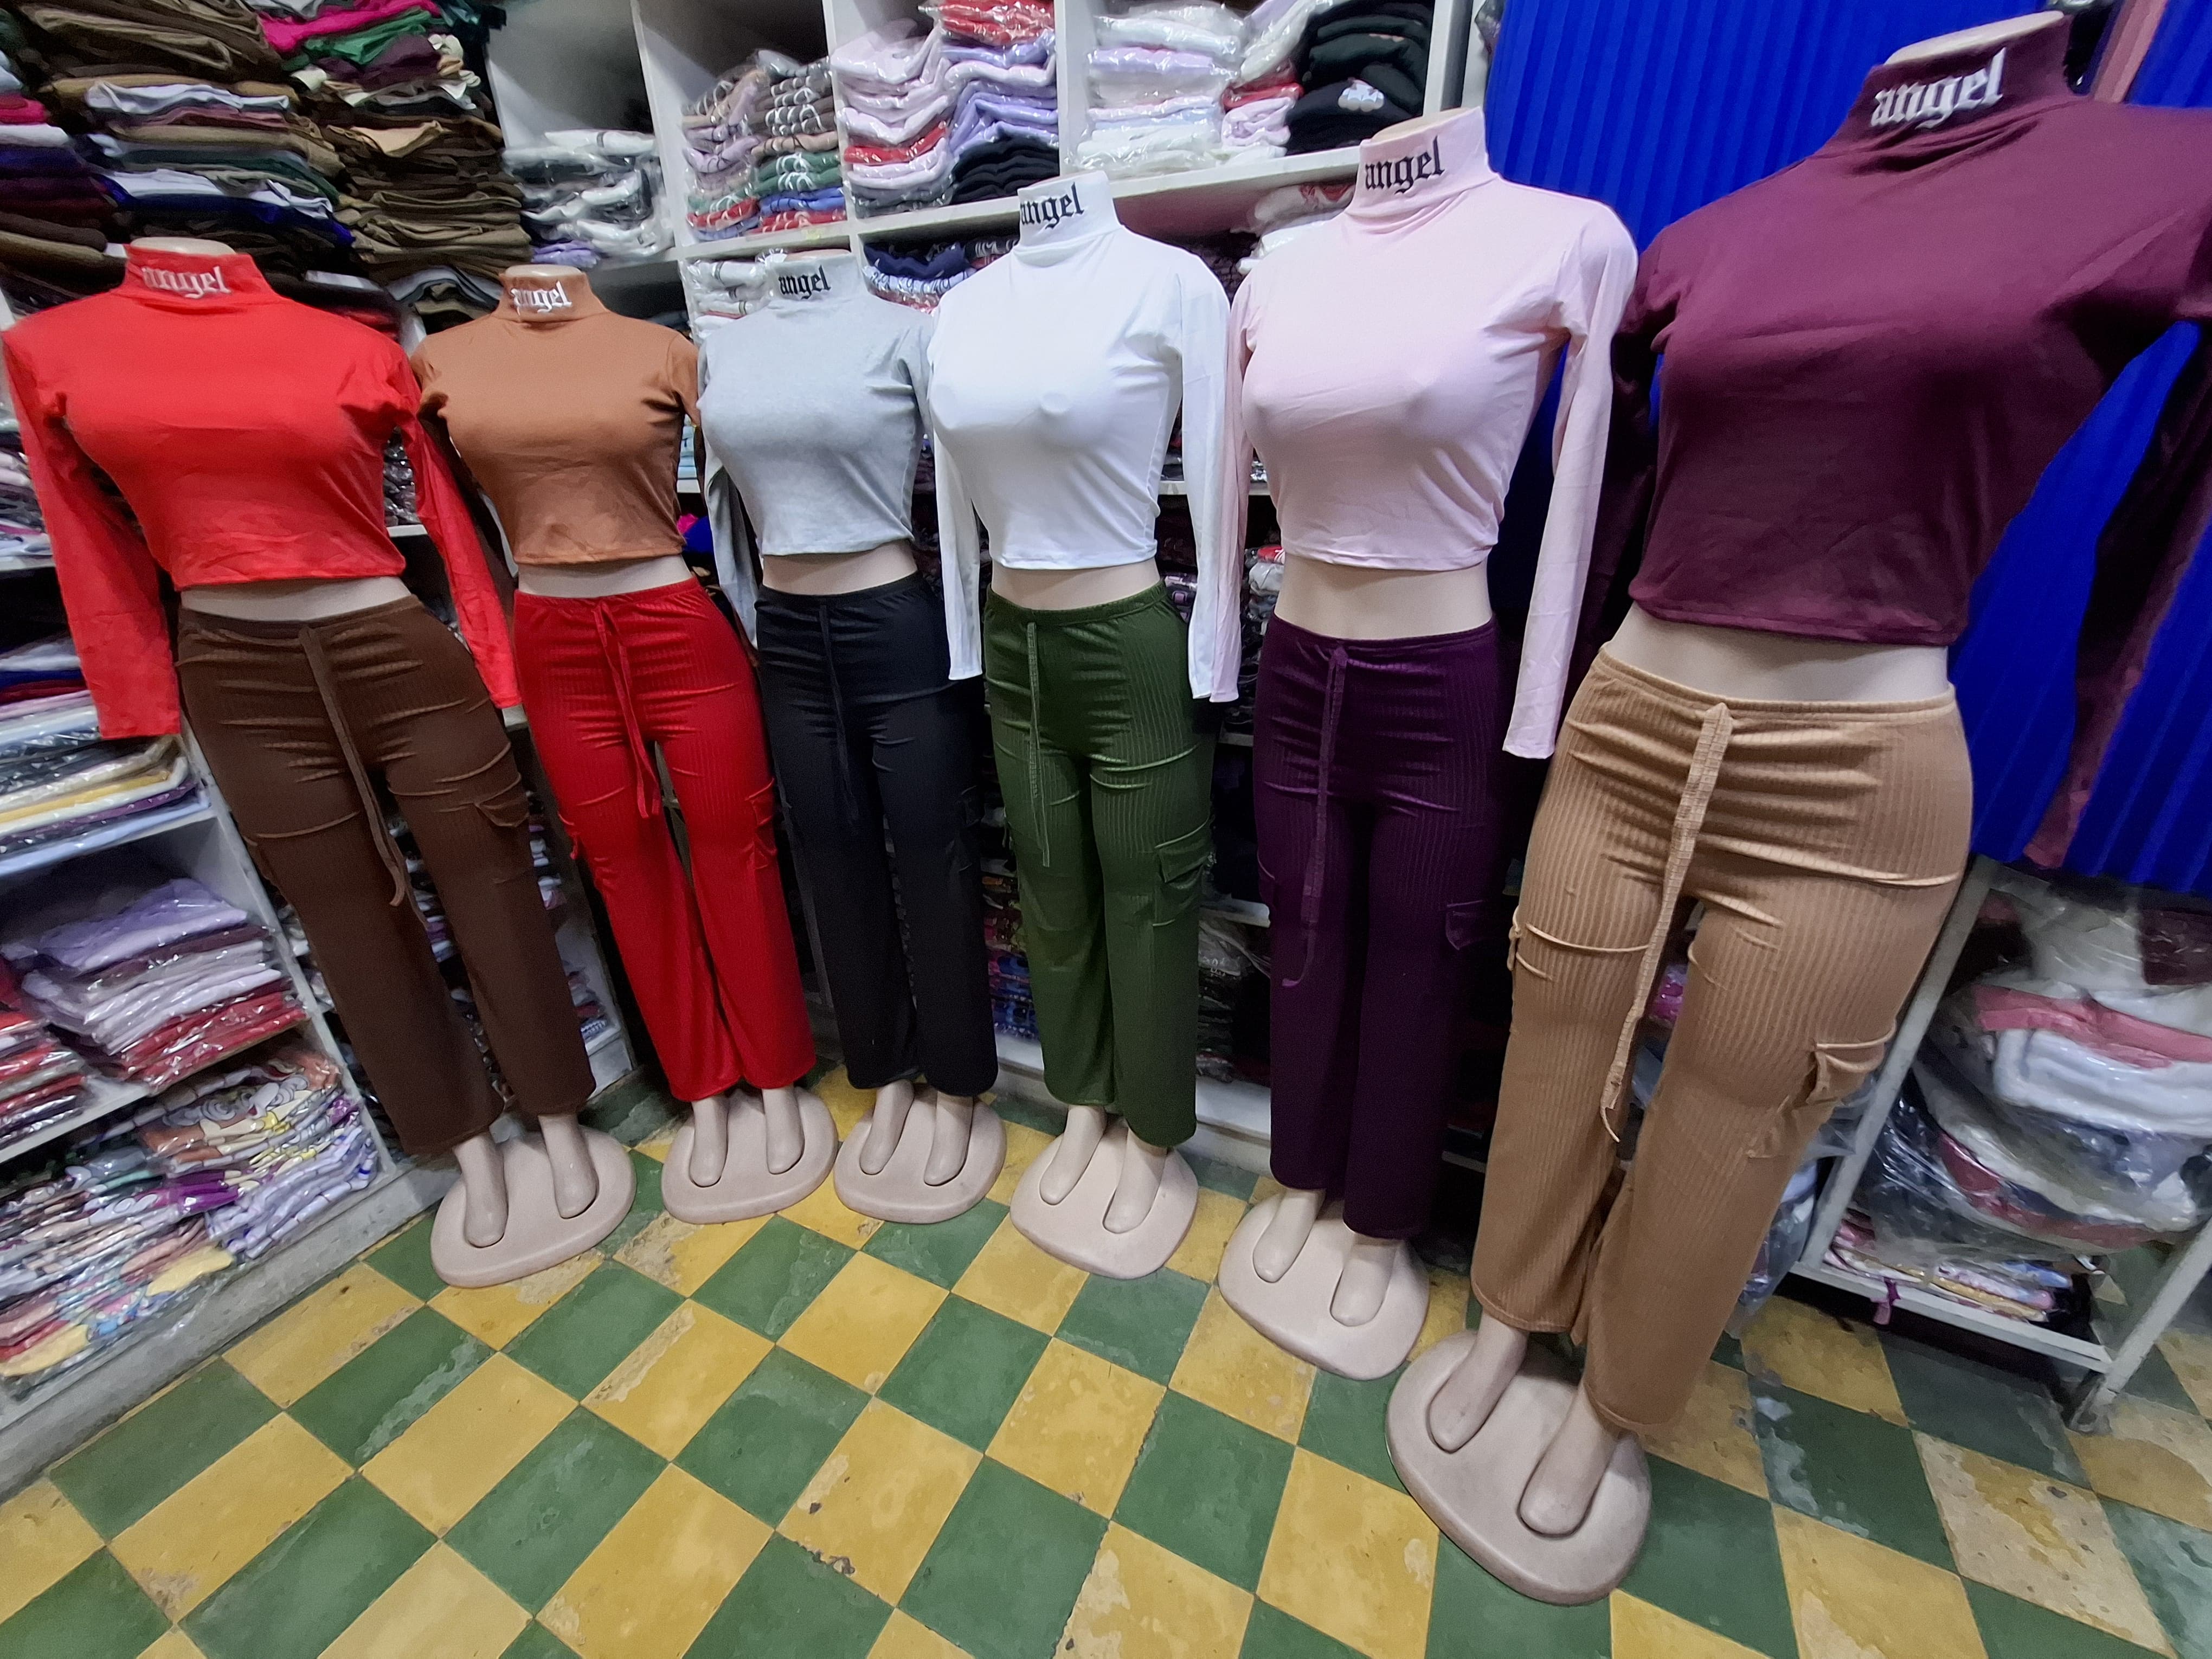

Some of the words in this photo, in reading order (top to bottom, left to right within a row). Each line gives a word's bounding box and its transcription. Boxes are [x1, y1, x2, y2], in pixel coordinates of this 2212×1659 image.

[1871, 47, 2005, 129] angel
[1365, 135, 1444, 195] angel
[1020, 182, 1084, 229] angel
[142, 265, 232, 299] angel
[511, 280, 573, 313] angel
[778, 265, 832, 300] angel
